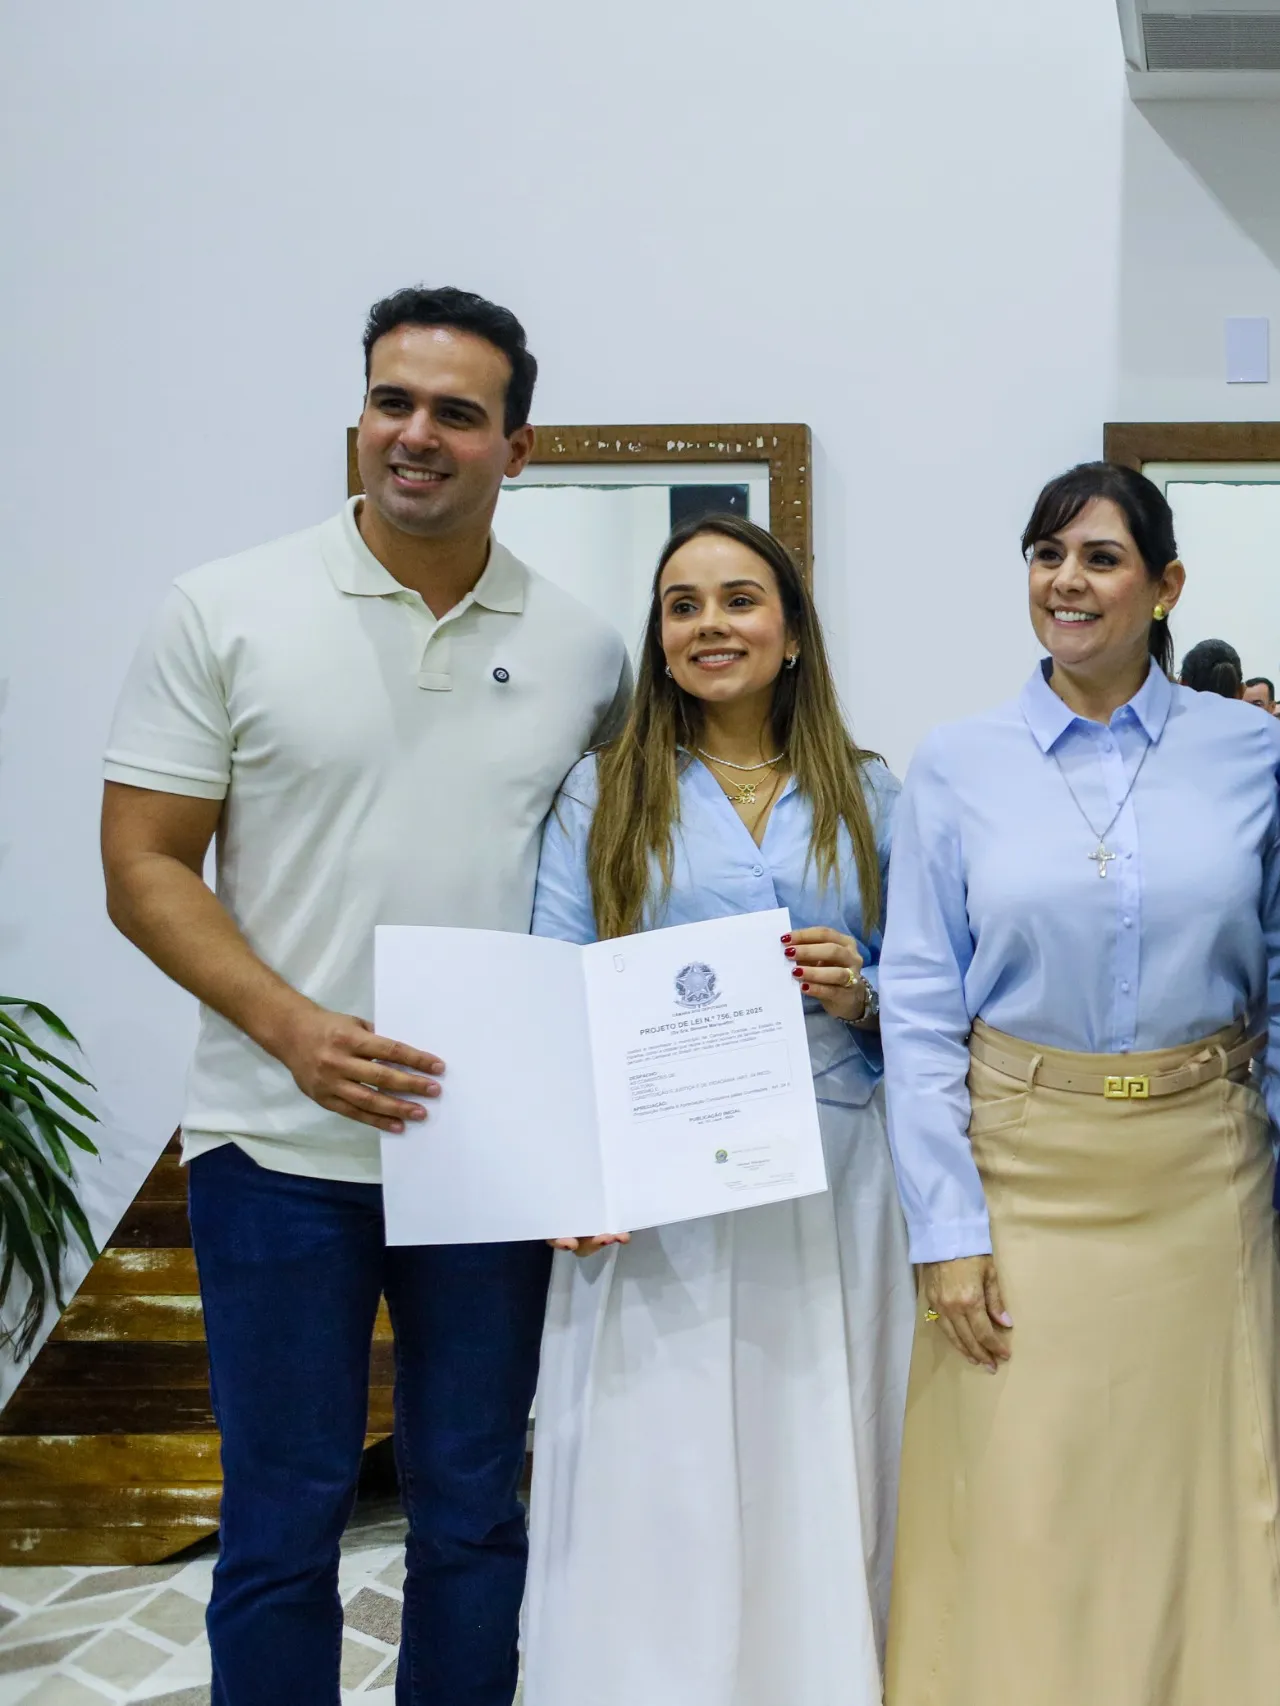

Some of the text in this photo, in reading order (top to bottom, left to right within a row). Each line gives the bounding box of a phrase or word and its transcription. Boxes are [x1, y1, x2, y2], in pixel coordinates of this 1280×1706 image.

[639, 1023, 676, 1035] PROJETO
[678, 1020, 689, 1029] DE
[690, 1017, 703, 1026] LEI
[733, 1010, 744, 1018] DE
[745, 1006, 763, 1016] 2025
